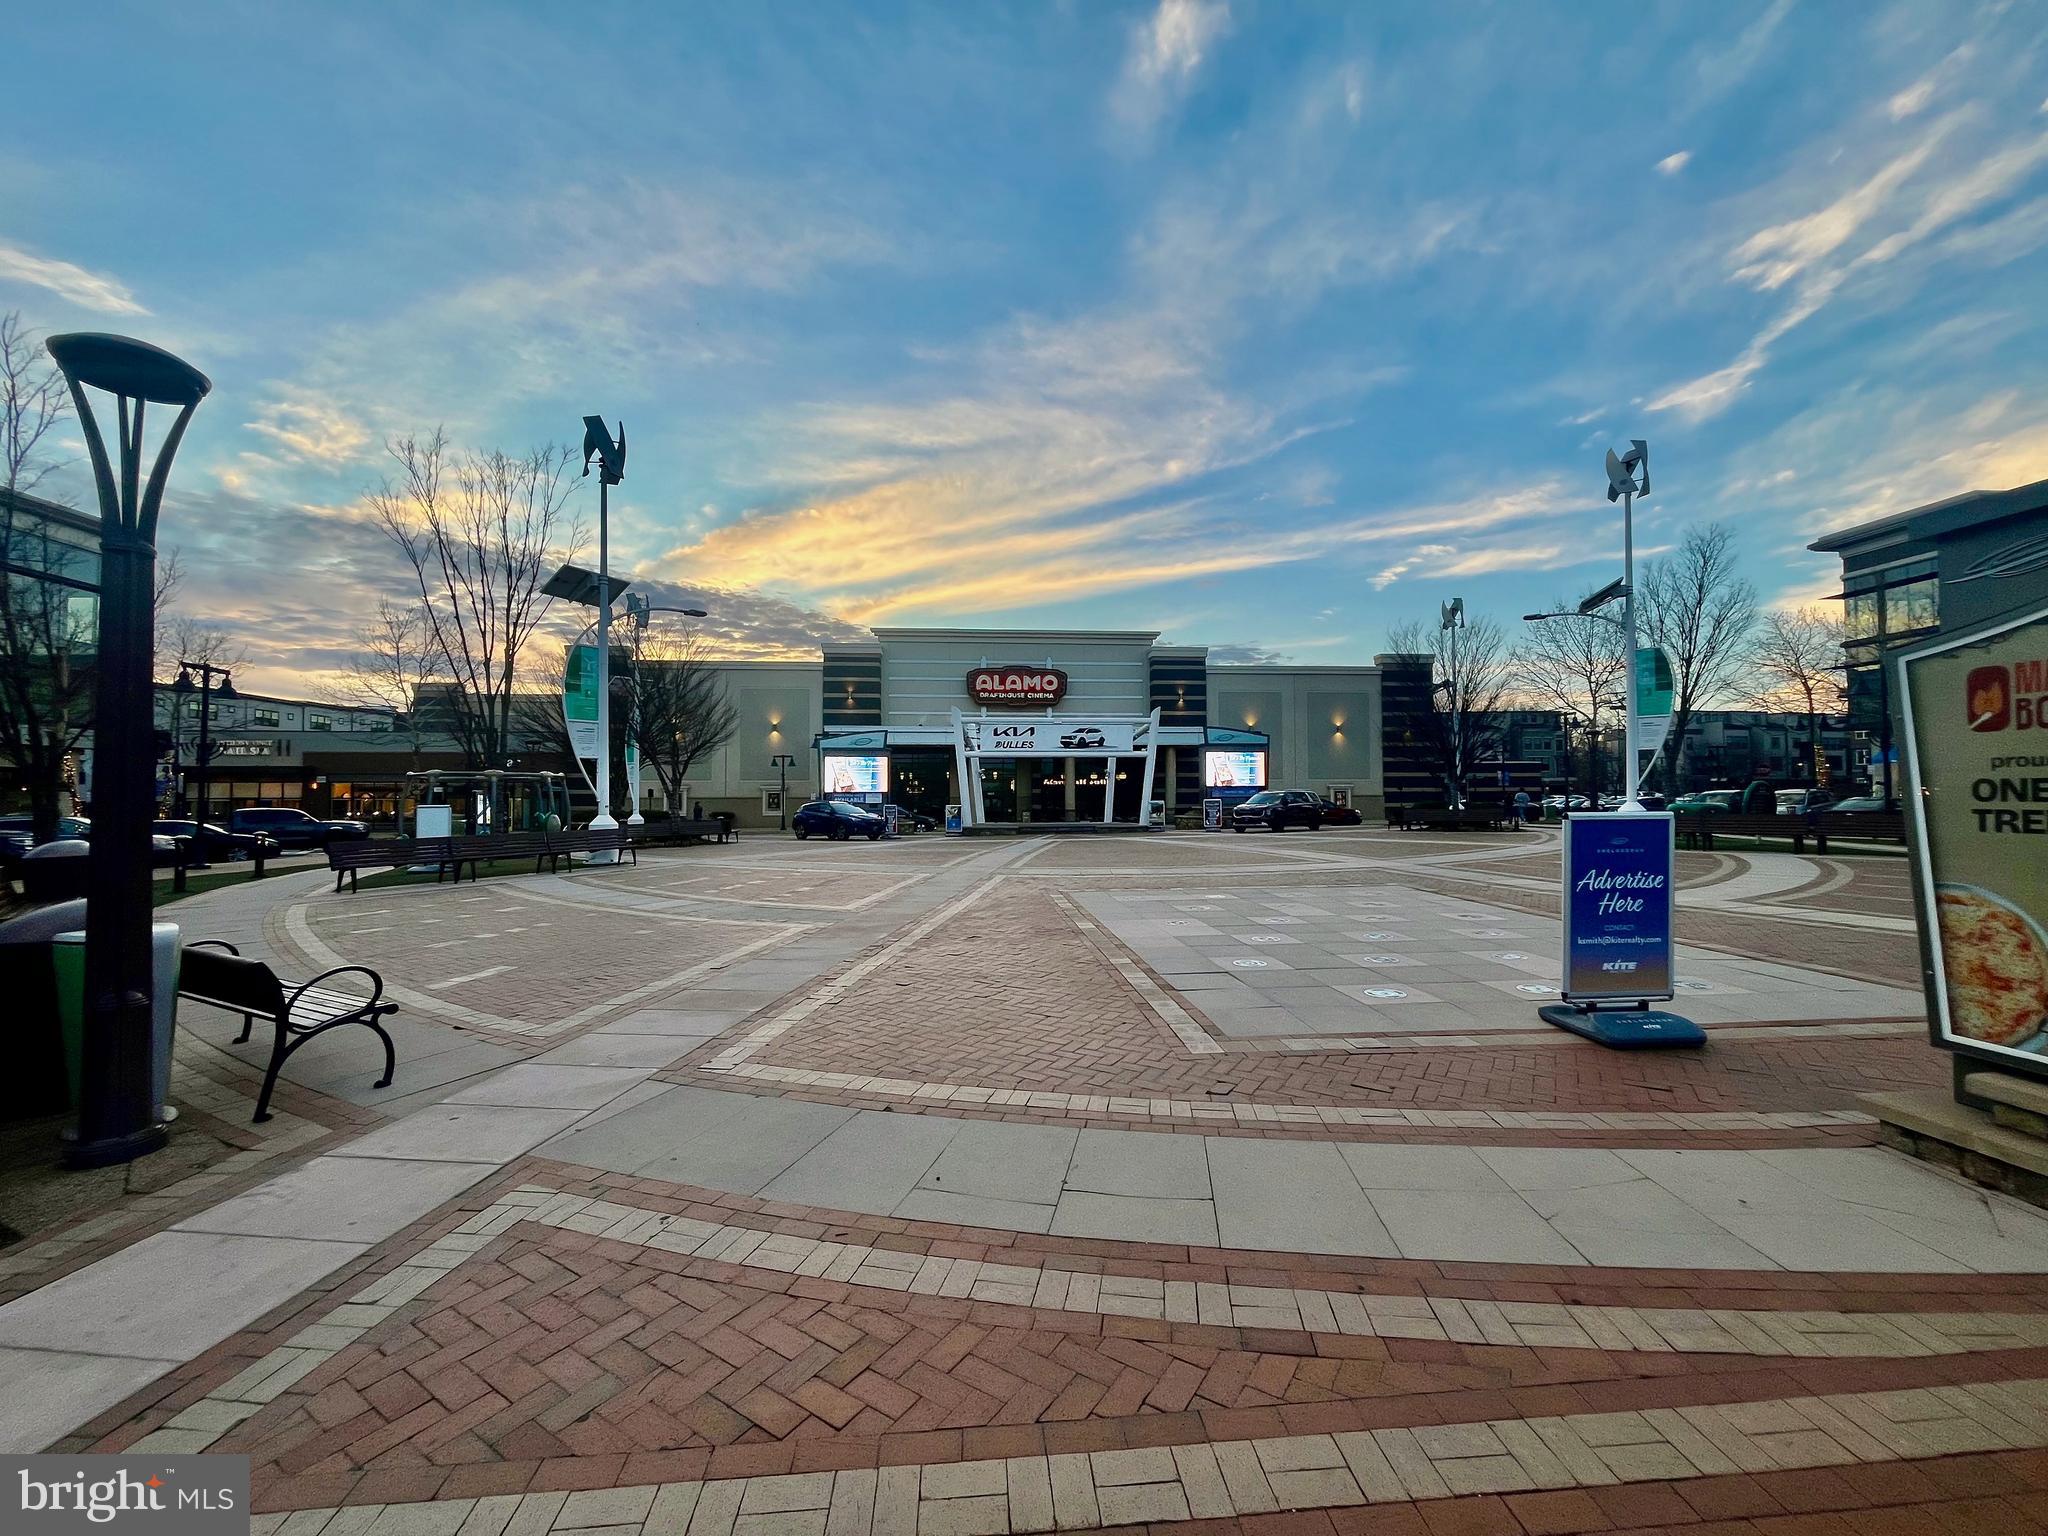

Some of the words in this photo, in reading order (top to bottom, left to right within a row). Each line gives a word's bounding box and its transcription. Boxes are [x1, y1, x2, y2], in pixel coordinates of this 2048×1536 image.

[976, 675, 1058, 690] ALAMO
[993, 726, 1035, 737] KIA
[995, 740, 1035, 749] DULLES
[1972, 778, 2048, 803] ONE
[1576, 869, 1664, 892] Advertise
[1598, 892, 1644, 915] Here
[1602, 960, 1638, 971] KITE
